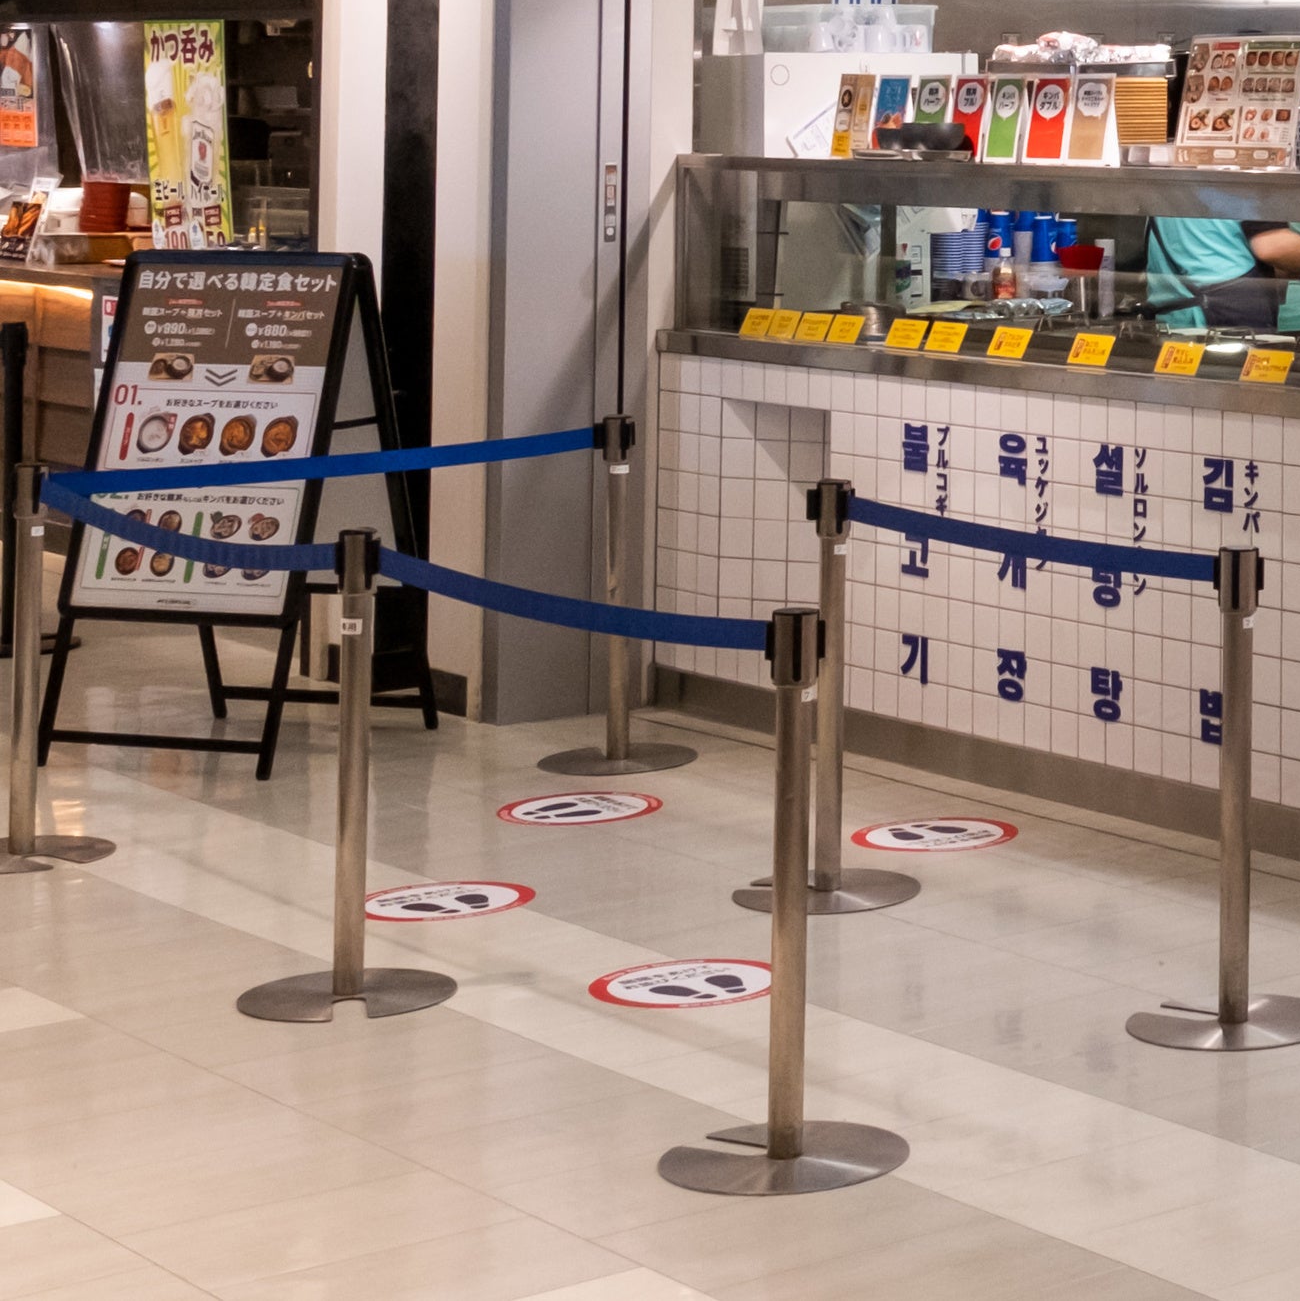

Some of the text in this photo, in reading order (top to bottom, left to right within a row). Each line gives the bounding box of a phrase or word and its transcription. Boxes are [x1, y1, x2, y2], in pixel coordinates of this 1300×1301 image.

[150, 28, 214, 64] かつ呑み
[114, 384, 142, 405] 01.
[935, 426, 950, 517] ブルコギ
[1242, 460, 1260, 533] キンパ
[1132, 448, 1148, 595] ソルロンン
